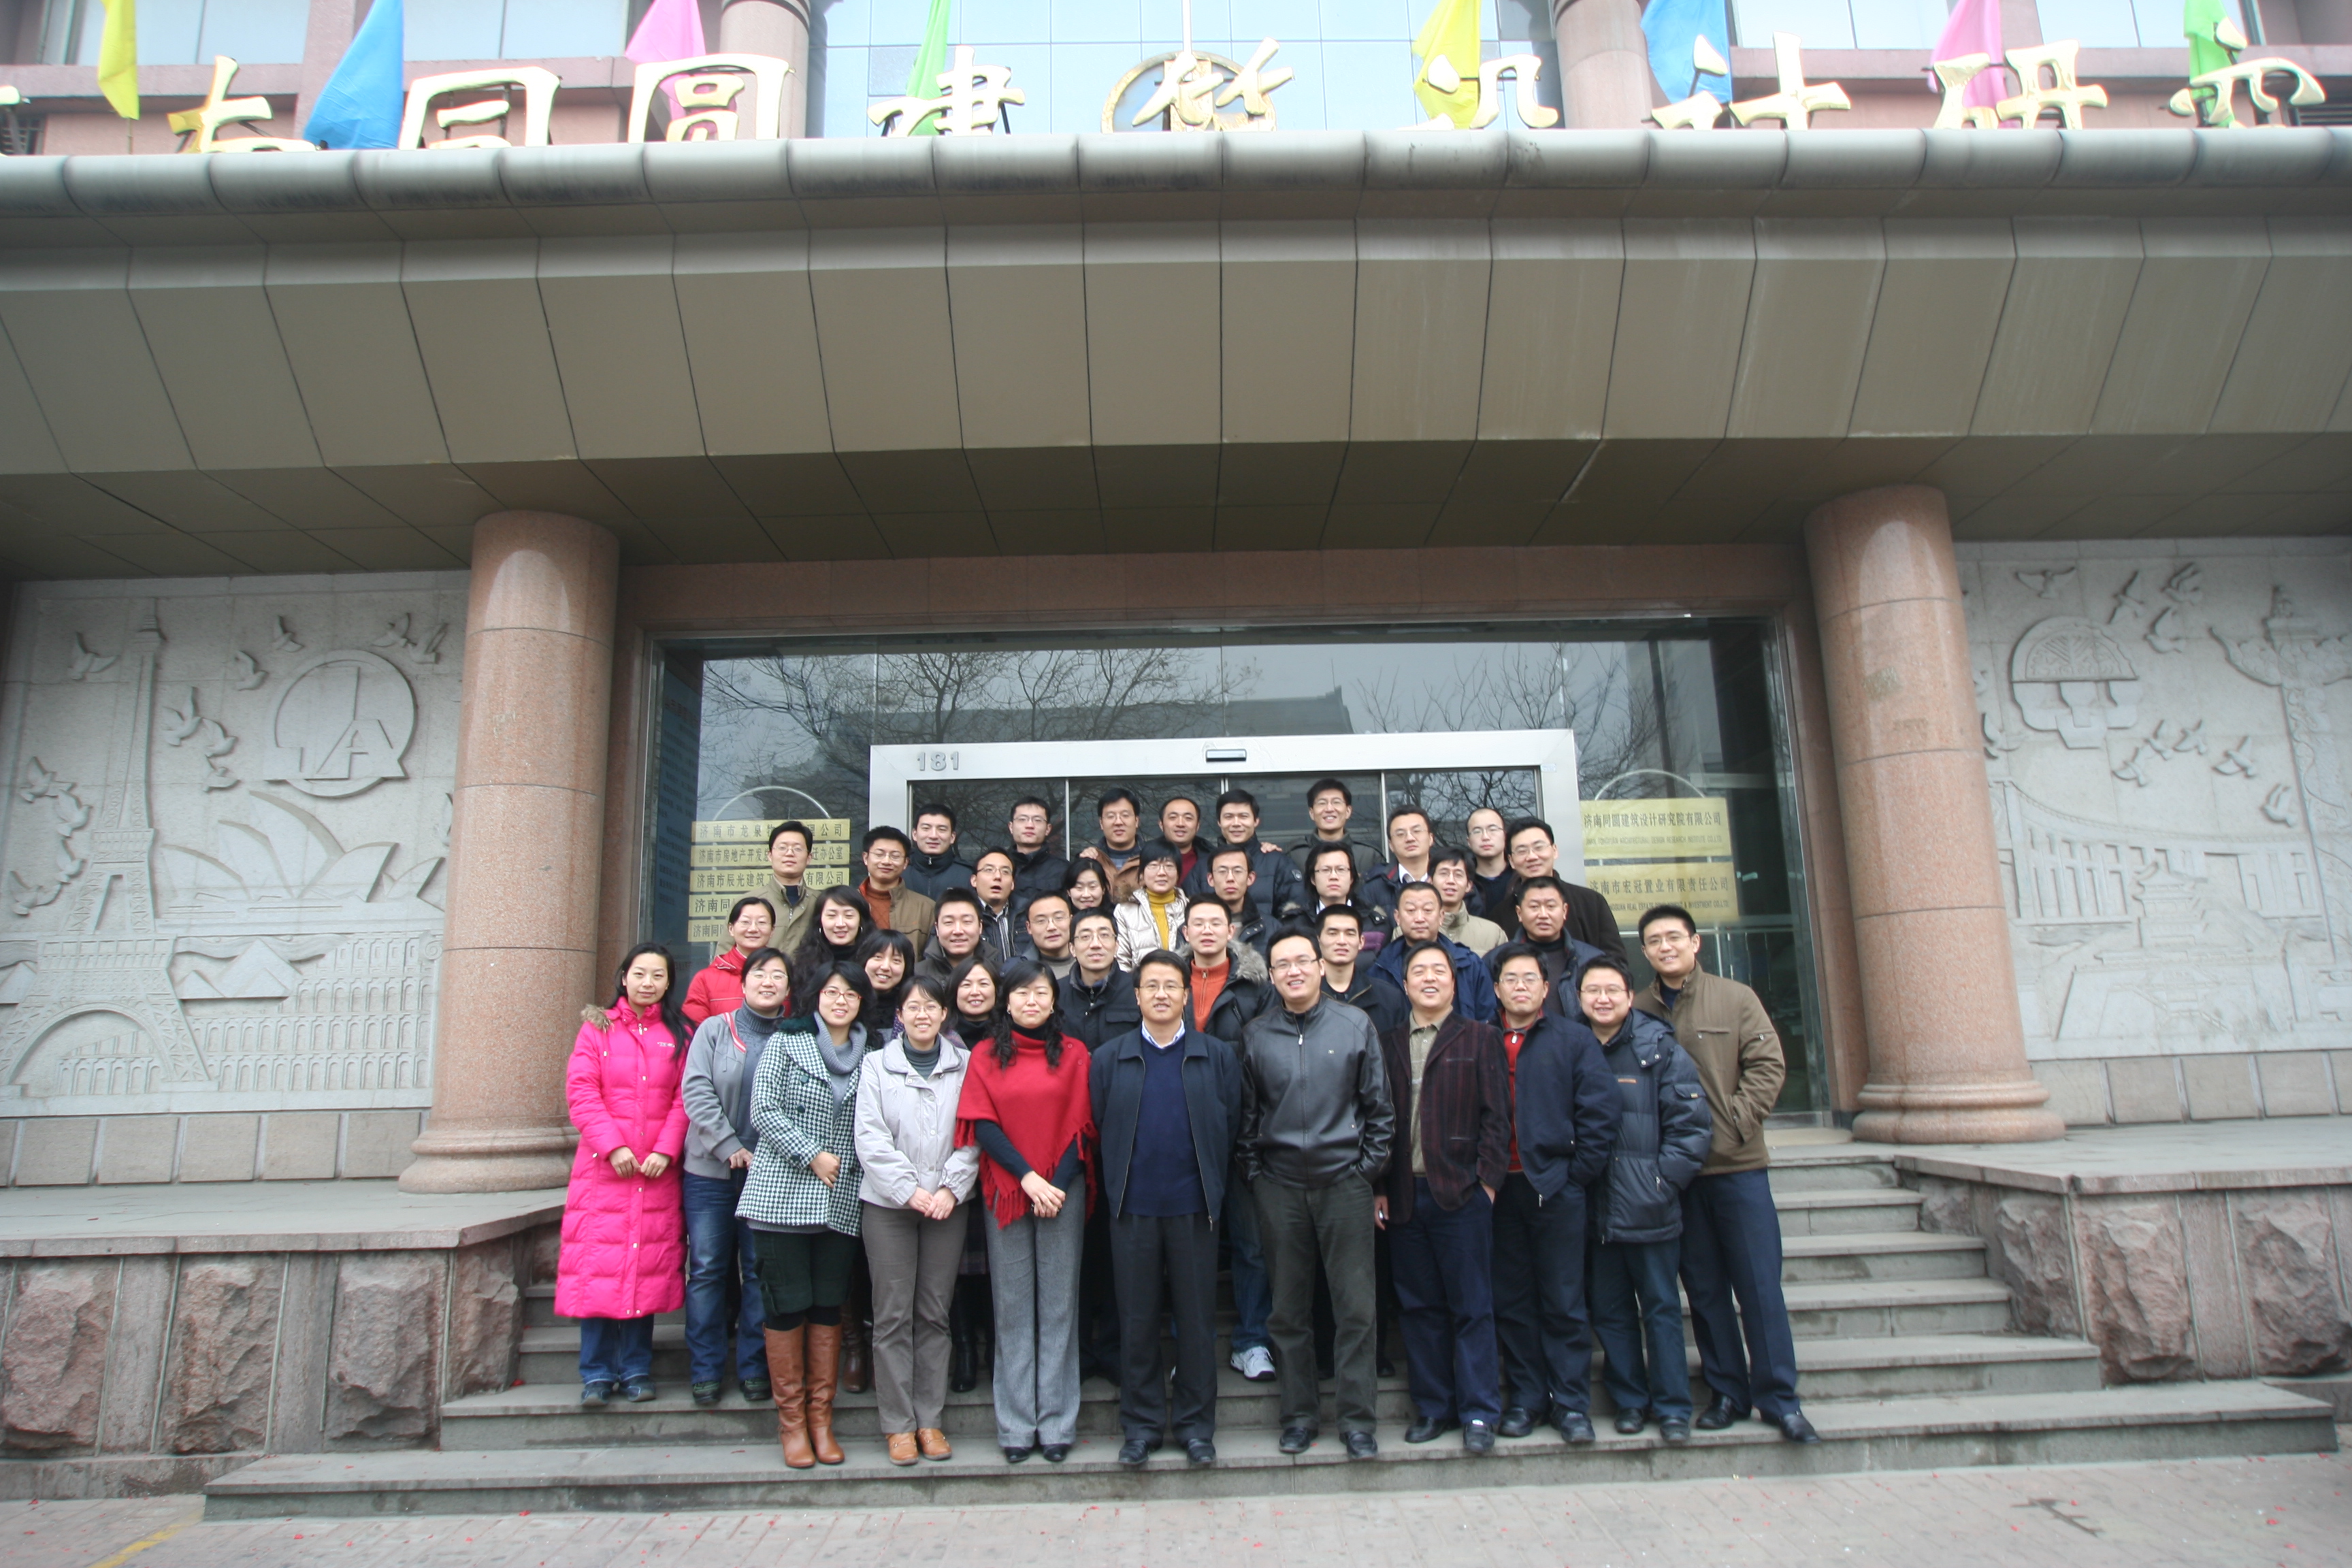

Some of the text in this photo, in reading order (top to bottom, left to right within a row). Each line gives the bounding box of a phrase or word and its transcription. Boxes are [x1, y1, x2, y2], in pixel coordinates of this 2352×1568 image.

[917, 751, 959, 771] 181
[1584, 812, 1722, 828] 济南同圆建筑设计研究院有限公司
